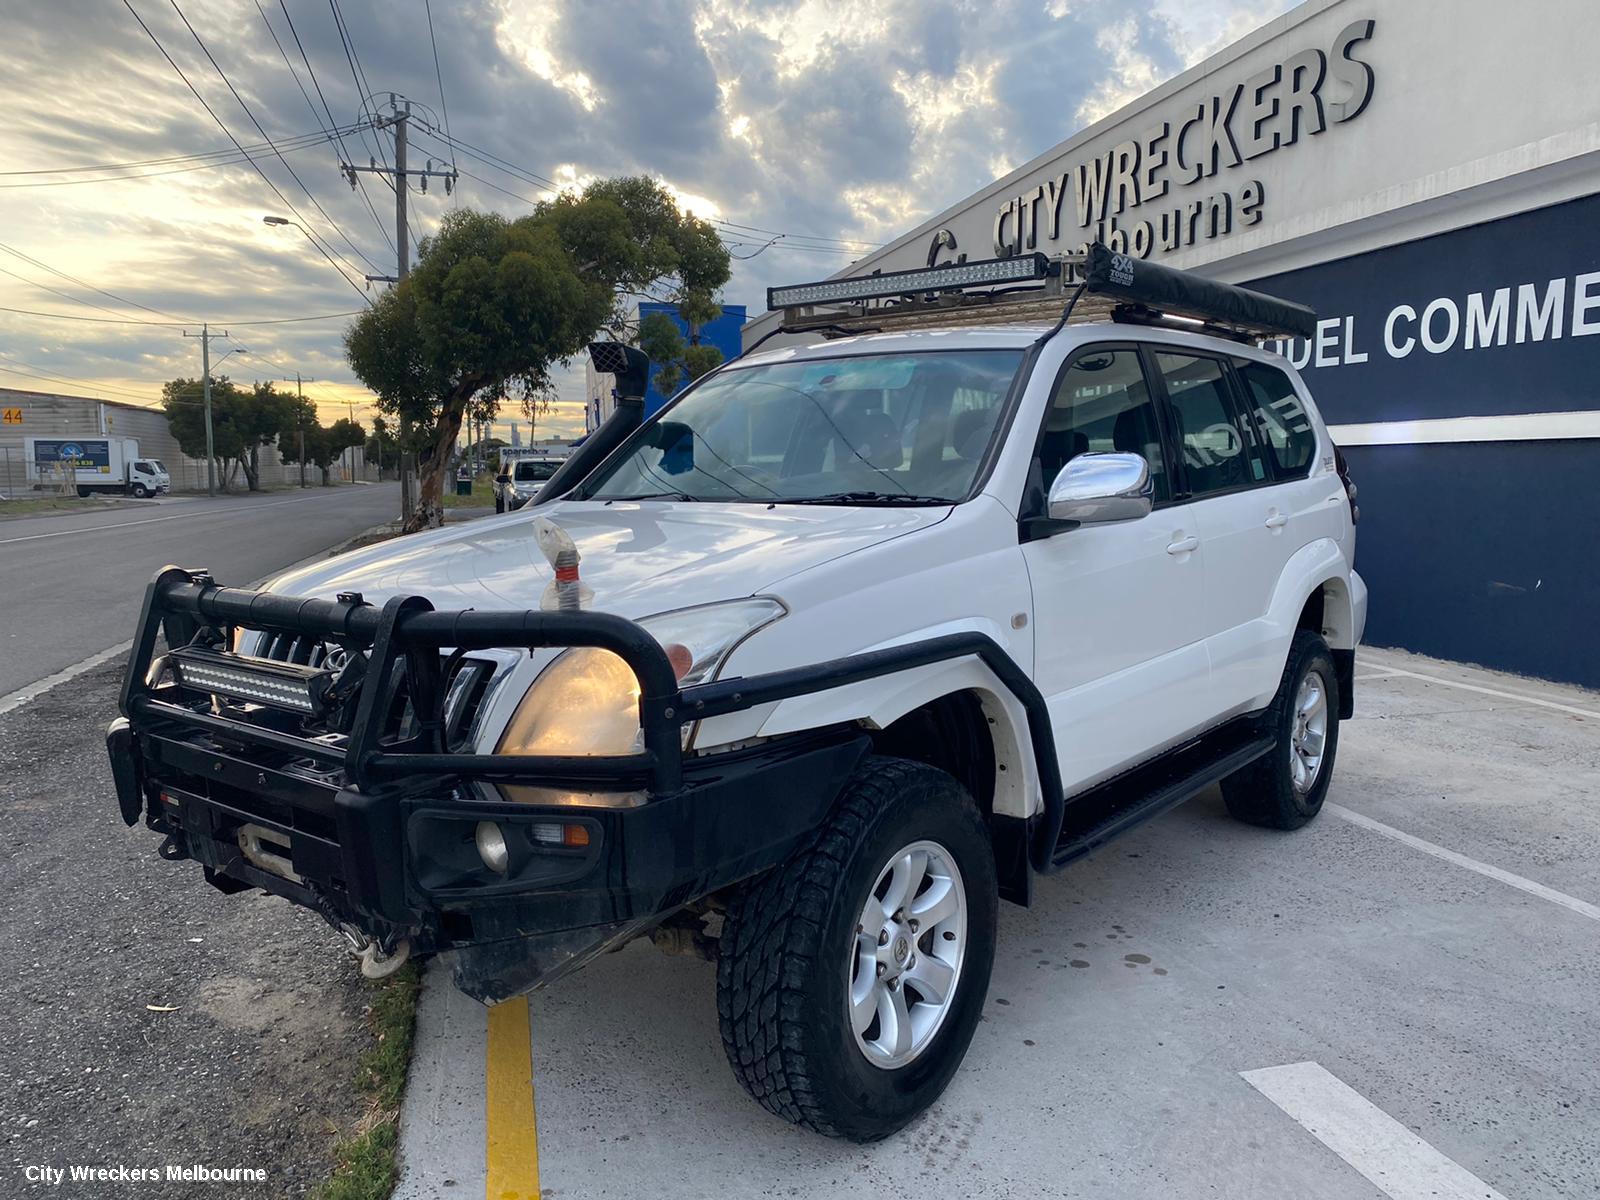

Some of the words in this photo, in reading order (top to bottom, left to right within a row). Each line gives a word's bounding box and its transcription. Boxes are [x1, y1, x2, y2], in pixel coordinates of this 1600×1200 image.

[993, 173, 1069, 257] CITY
[1074, 20, 1376, 228] WRECKERS
[3, 408, 22, 424] 44
[502, 447, 549, 456] sparesbox
